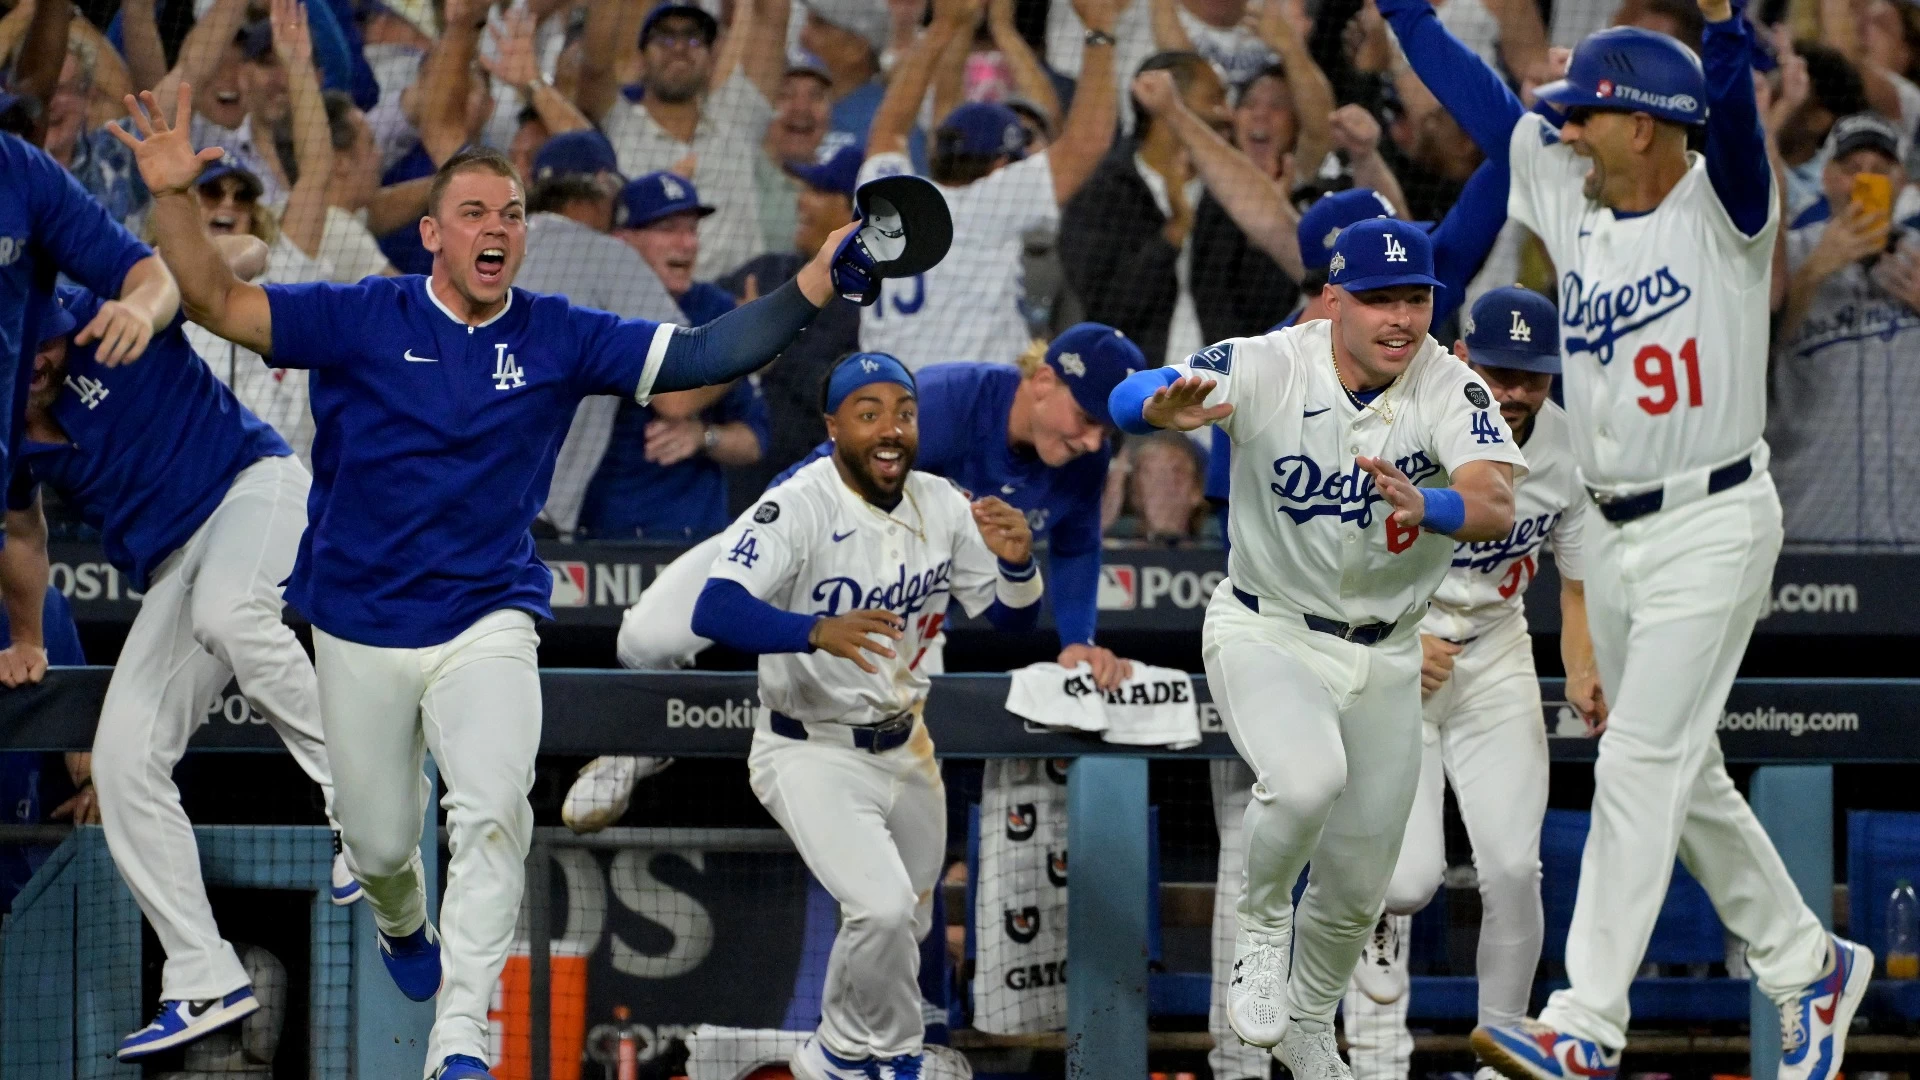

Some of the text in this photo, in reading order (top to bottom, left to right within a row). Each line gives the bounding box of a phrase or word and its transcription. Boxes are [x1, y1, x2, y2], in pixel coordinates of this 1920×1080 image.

[1382, 233, 1408, 263] LA
[1509, 310, 1532, 342] LA
[492, 343, 527, 390] LA
[1633, 337, 1703, 416] 91
[63, 374, 110, 410] LA
[1470, 411, 1504, 444] LA
[1271, 450, 1441, 529] Dodgrs
[728, 528, 760, 569] LA
[1385, 511, 1420, 555] 6
[48, 562, 145, 601] OST
[812, 559, 951, 632] Dodger
[1063, 674, 1189, 706] GARADE
